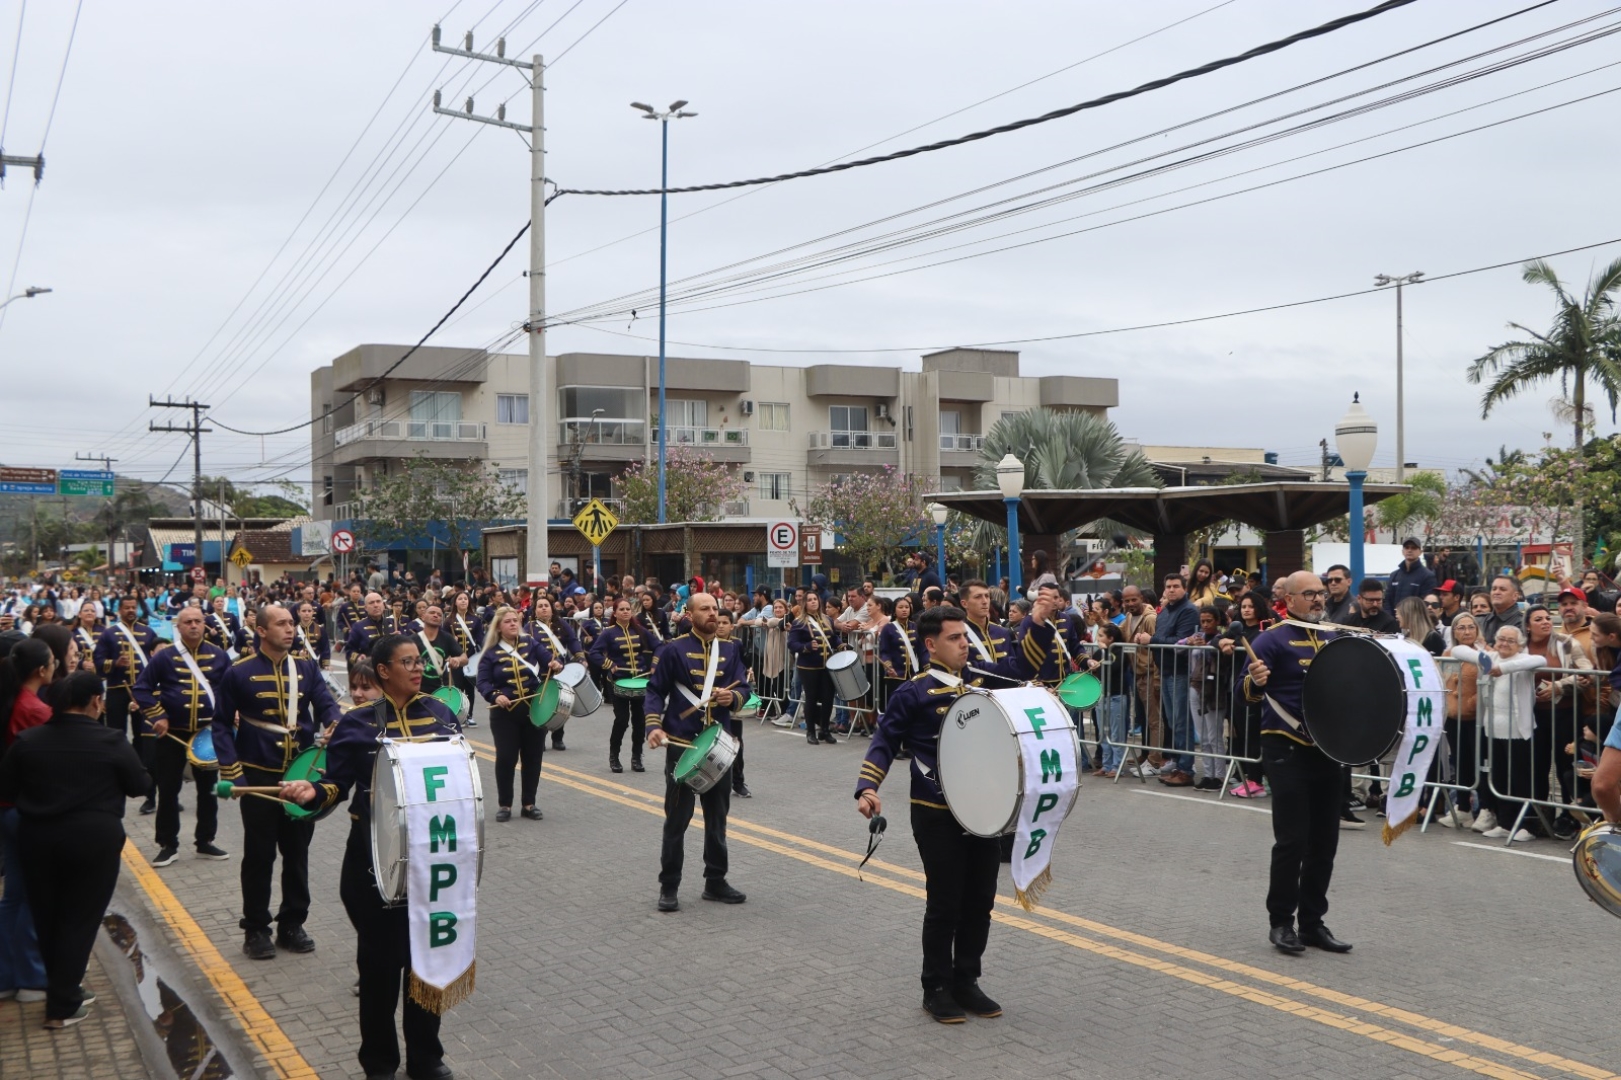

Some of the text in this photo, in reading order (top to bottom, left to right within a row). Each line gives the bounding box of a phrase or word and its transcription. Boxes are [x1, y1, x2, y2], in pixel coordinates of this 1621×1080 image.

[778, 530, 788, 543] E
[181, 549, 196, 557] TIM
[963, 707, 980, 720] LUEN
